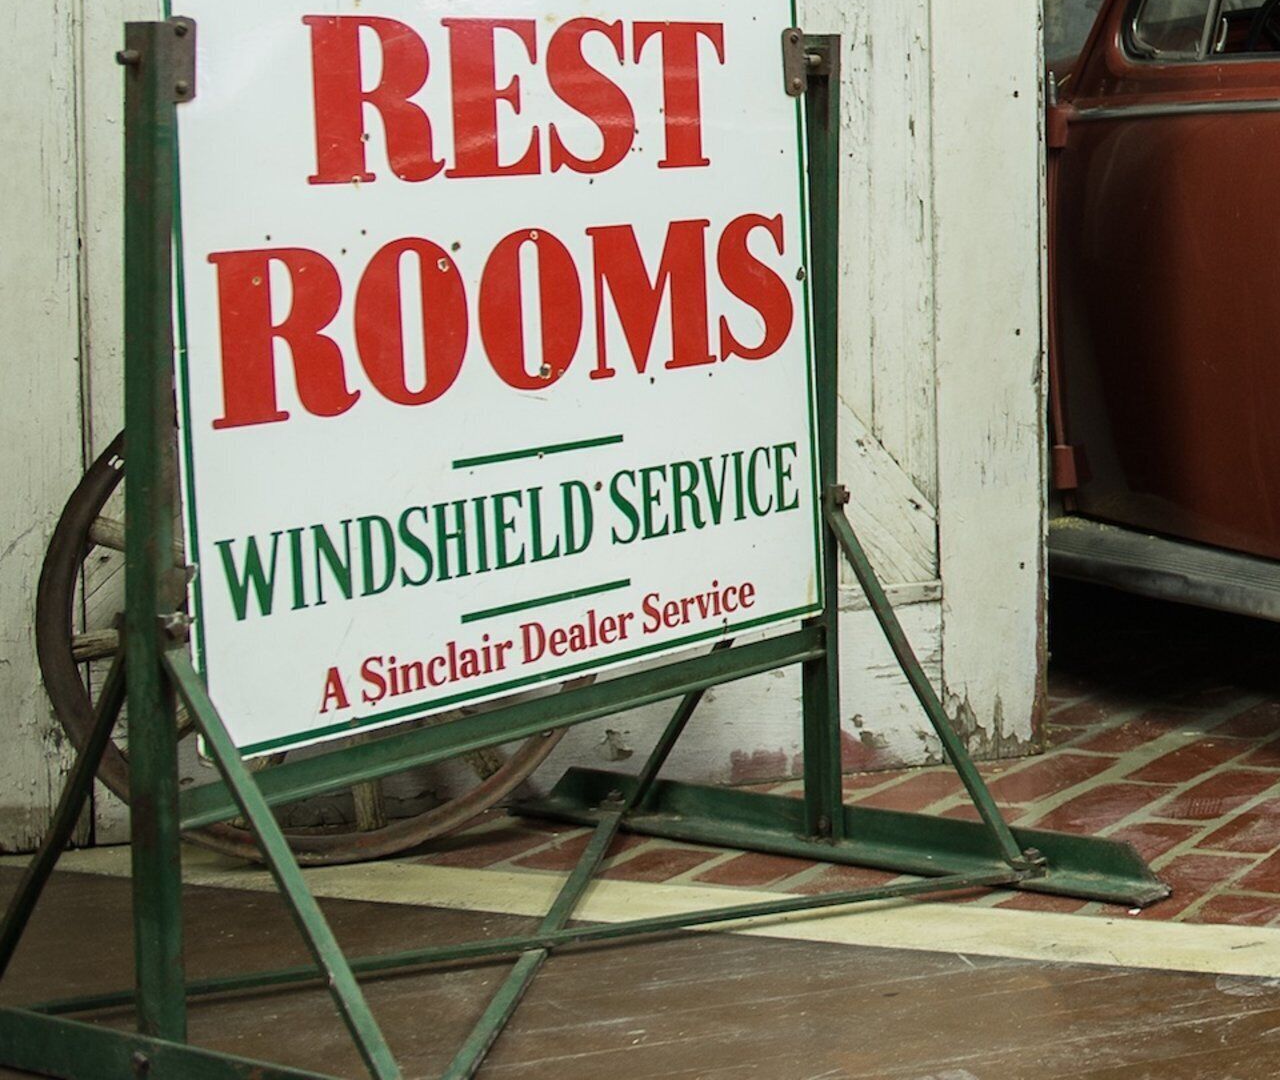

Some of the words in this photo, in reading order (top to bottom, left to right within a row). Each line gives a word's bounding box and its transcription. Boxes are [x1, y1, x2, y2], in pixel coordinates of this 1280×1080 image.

[302, 14, 726, 185] REST
[207, 213, 795, 431] ROOMS
[214, 480, 596, 622] WINDSHIELD
[609, 442, 801, 546] SERVICE
[320, 665, 350, 715] A
[360, 634, 514, 707] Sinclair
[519, 607, 636, 665] Dealer
[641, 579, 757, 637] Service
